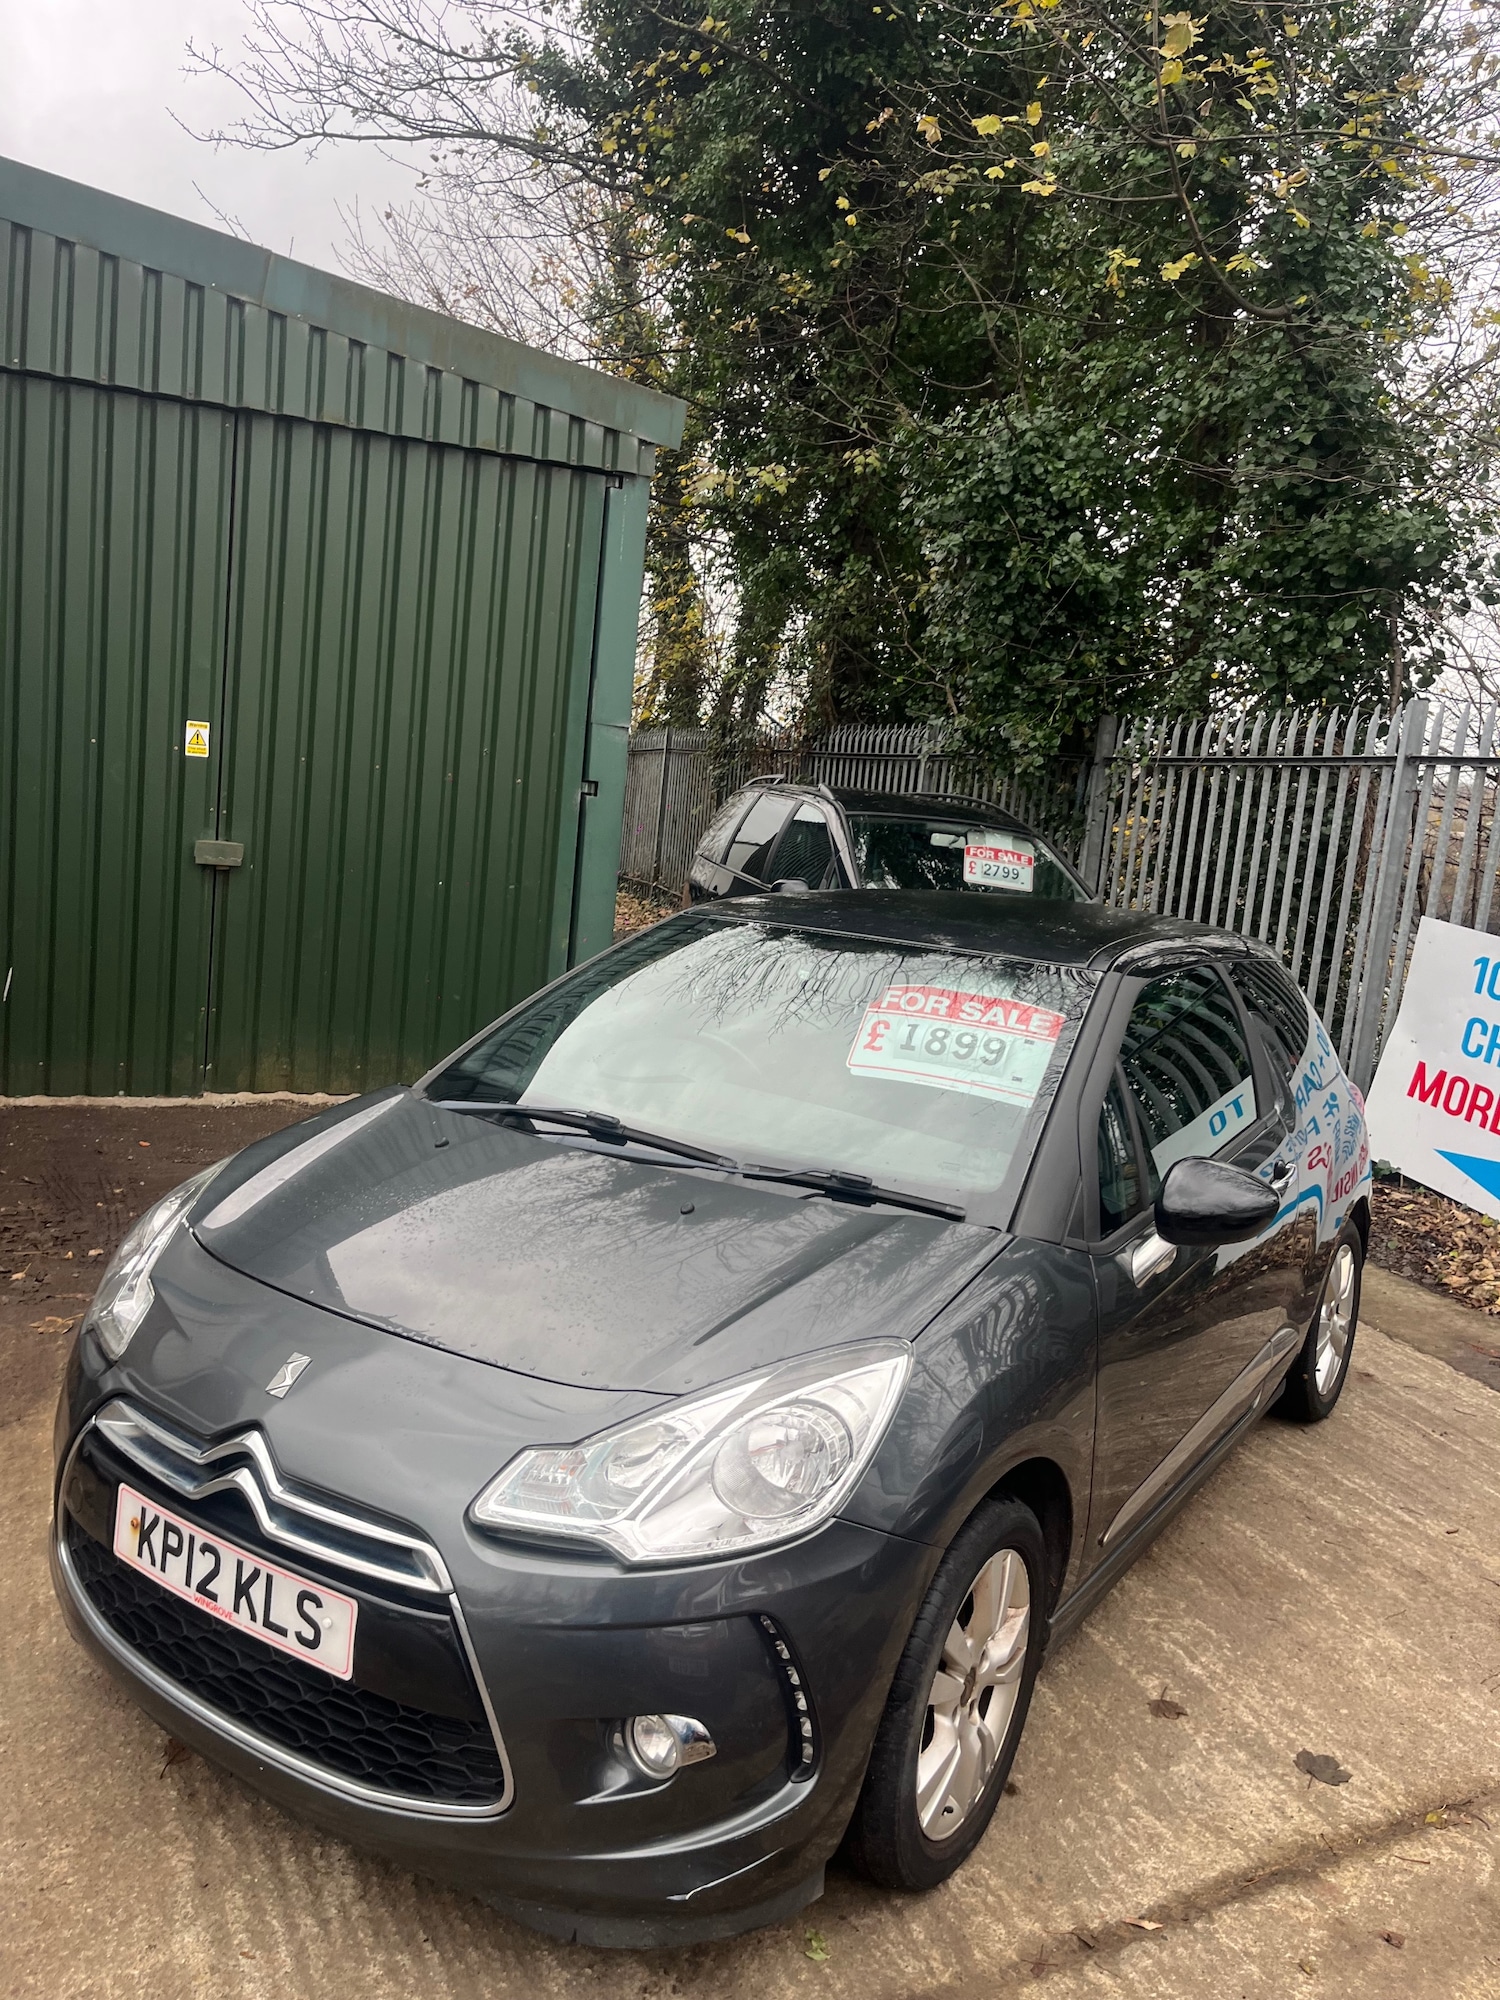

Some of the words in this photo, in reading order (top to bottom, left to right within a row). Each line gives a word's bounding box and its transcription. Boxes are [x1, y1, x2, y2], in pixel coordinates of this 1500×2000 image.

[968, 861, 977, 874] £
[983, 863, 1020, 880] 2799
[970, 847, 995, 859] FOR
[998, 852, 1029, 865] SALE
[881, 990, 950, 1016] FOR
[959, 1001, 1052, 1034] SALE
[863, 1020, 890, 1051] £
[900, 1023, 1007, 1066] 1899
[137, 1506, 221, 1604] KP12
[233, 1558, 323, 1650] KLS
